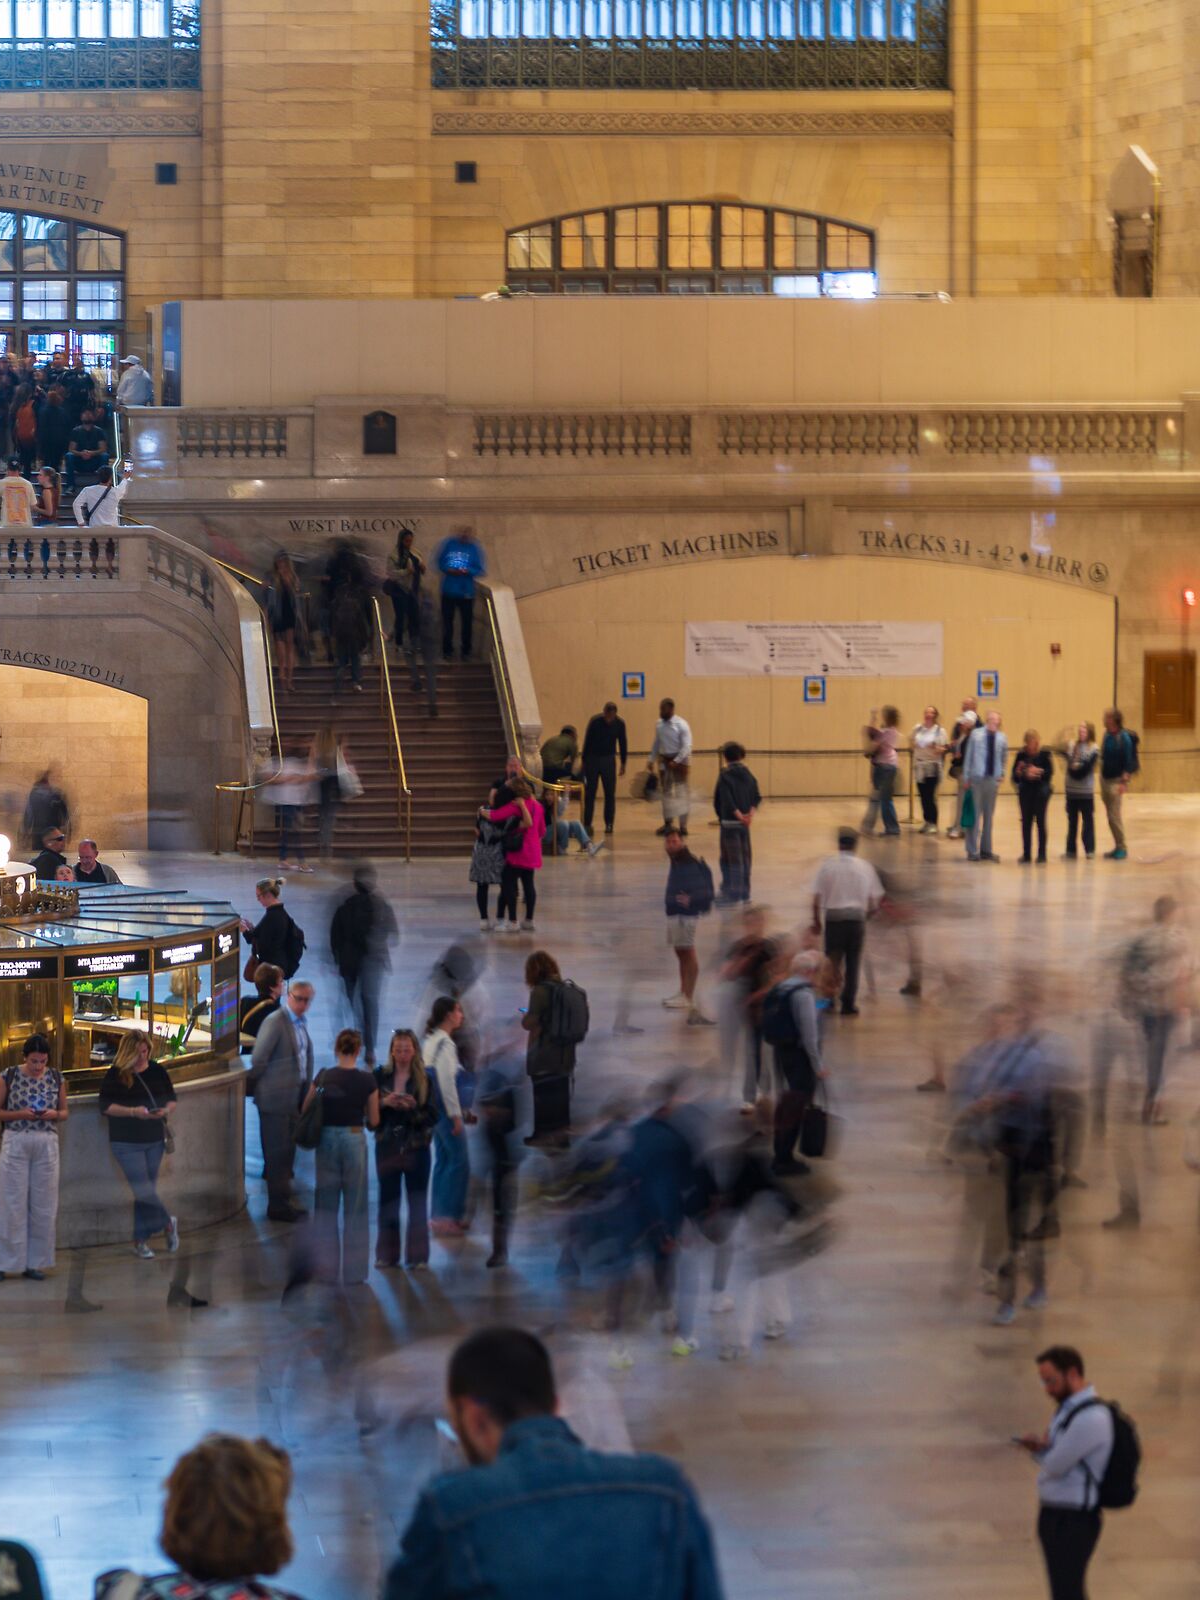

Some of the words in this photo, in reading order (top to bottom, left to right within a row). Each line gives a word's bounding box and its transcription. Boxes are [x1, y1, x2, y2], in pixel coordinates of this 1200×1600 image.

[288, 519, 335, 532] WEST
[572, 543, 651, 573] TICKET
[660, 529, 779, 558] MACHINES
[858, 529, 947, 554] TRACKS
[953, 539, 970, 556] 31
[988, 543, 1015, 562] 42
[1035, 551, 1083, 579] LIRR
[54, 657, 76, 673] 102
[80, 663, 100, 678] TO
[104, 669, 125, 685] 114
[78, 957, 91, 967] MTA
